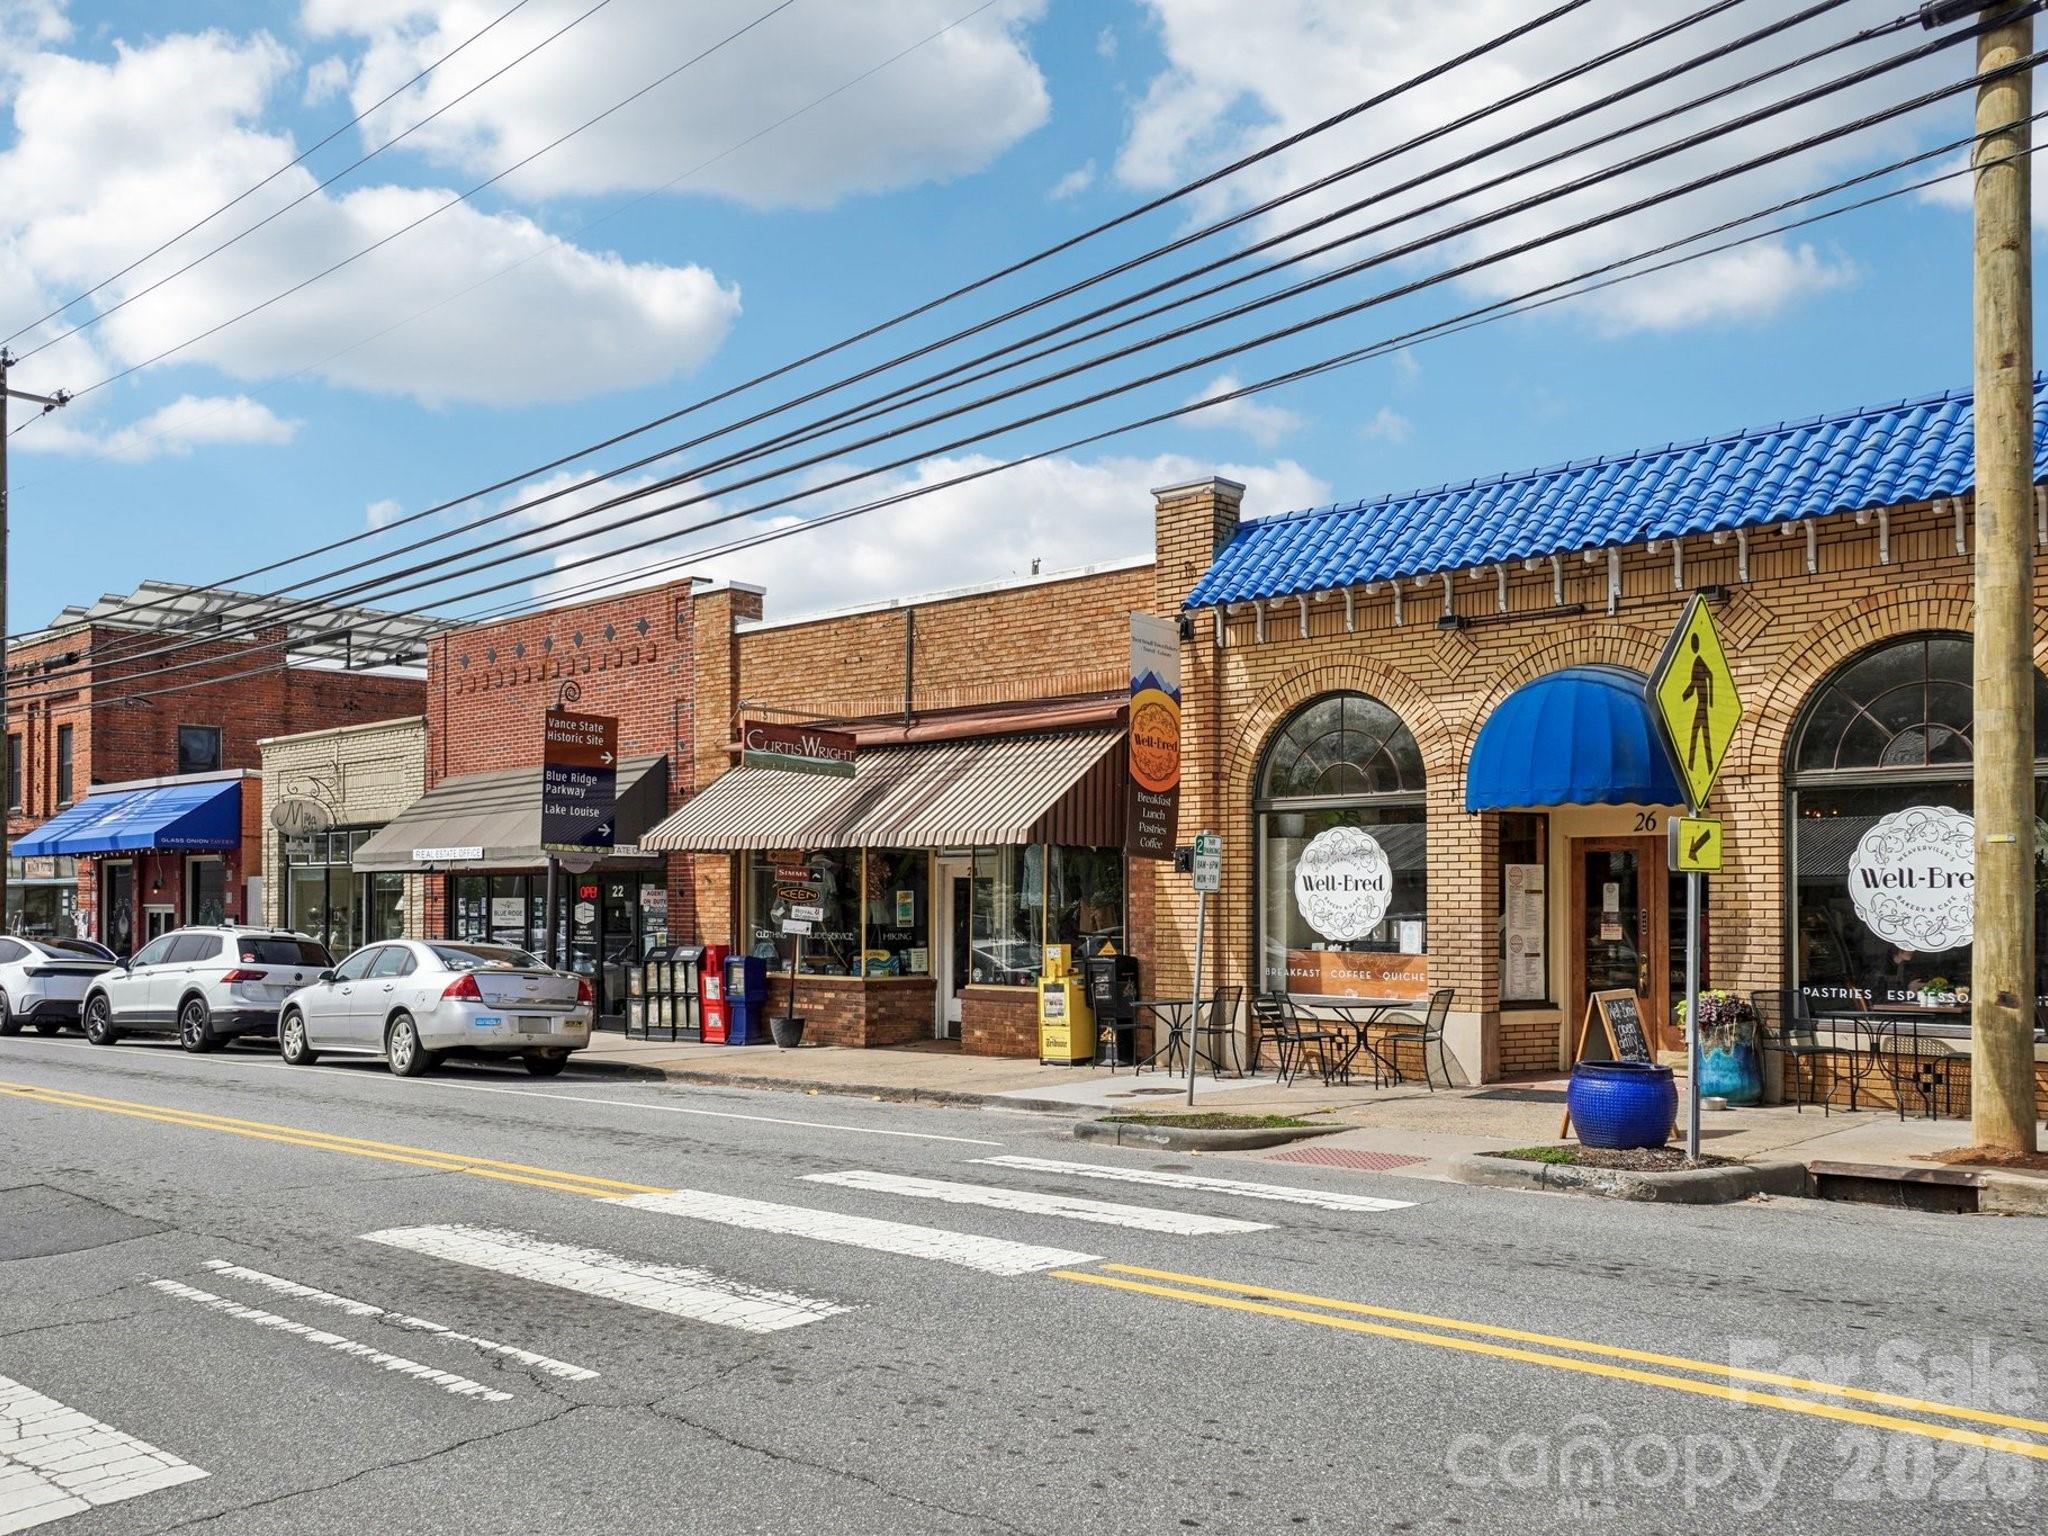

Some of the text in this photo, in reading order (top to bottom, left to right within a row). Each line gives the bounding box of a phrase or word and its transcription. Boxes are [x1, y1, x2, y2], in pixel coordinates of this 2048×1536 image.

[548, 717, 604, 733] Vance State
[547, 731, 604, 746] Historic Site
[1134, 732, 1178, 752] Well-Bred
[546, 770, 598, 786] Blue Ridge
[545, 784, 586, 798] Parkway
[1137, 791, 1171, 807] Breakfast
[545, 804, 600, 817] Lake Louise
[1142, 807, 1166, 820] Lunch
[1633, 811, 1657, 832] 26
[1138, 822, 1168, 836] Pastries
[1139, 837, 1163, 850] Coffee
[1196, 838, 1204, 853] 2
[415, 847, 481, 860] REAL ESTATE OFFICE
[779, 869, 808, 877] SIMMS
[1860, 867, 1974, 889] Well-Bre
[1302, 874, 1385, 892] Well-Bred
[612, 885, 624, 897] 22
[780, 890, 817, 899] KEEN
[755, 930, 787, 939] CLOTHING
[882, 932, 912, 940] HIKING
[1265, 967, 1426, 982] BREAKFAST COFFEE QUICHE
[1803, 986, 1872, 1000] PASTRIES
